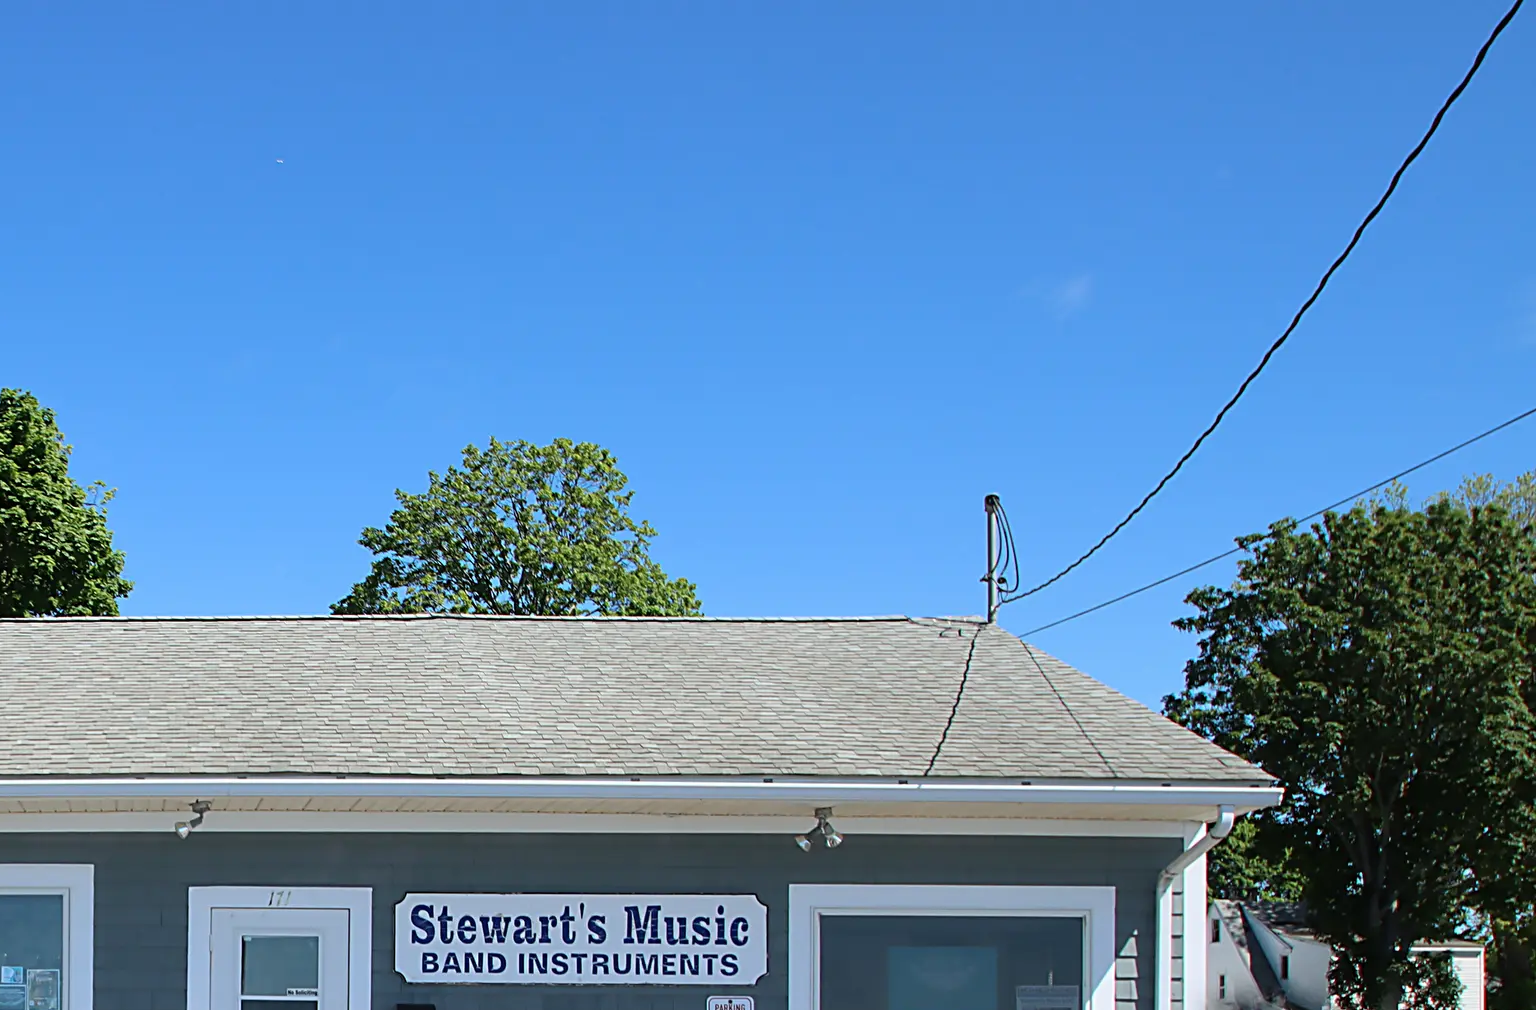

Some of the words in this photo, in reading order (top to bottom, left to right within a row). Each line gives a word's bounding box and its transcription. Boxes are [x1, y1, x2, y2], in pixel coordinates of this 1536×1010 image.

[268, 891, 291, 906] 171
[410, 902, 607, 945] Stewart's
[623, 905, 749, 947] Music
[421, 952, 507, 974] BAND
[518, 953, 739, 976] INSTRUMENTS
